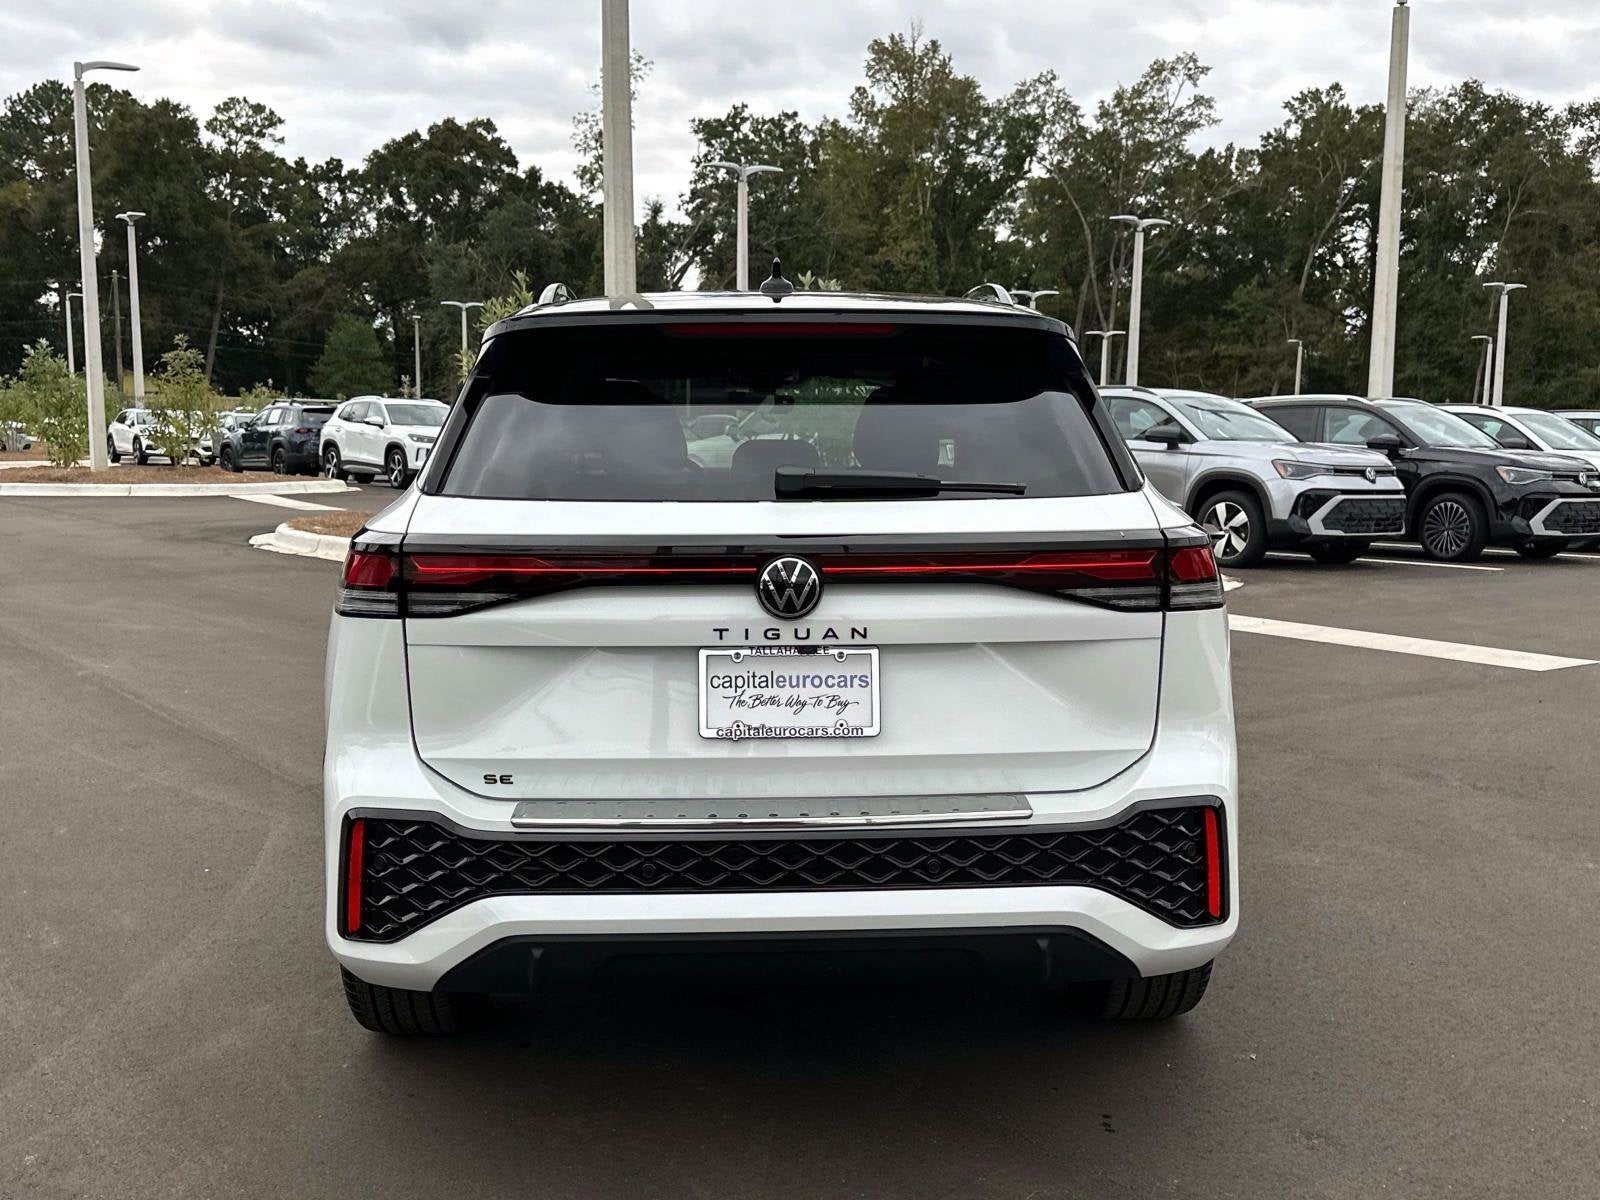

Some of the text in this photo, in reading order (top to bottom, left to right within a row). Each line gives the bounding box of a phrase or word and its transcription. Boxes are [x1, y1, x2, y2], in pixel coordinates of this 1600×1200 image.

[712, 627, 868, 641] TIGUAN
[750, 646, 830, 656] TALLAHAEE
[709, 670, 870, 693] capitaleurocars
[722, 689, 860, 715] The Better Way To Buy
[716, 724, 864, 741] capitaleurocars.com
[483, 774, 514, 784] SE
